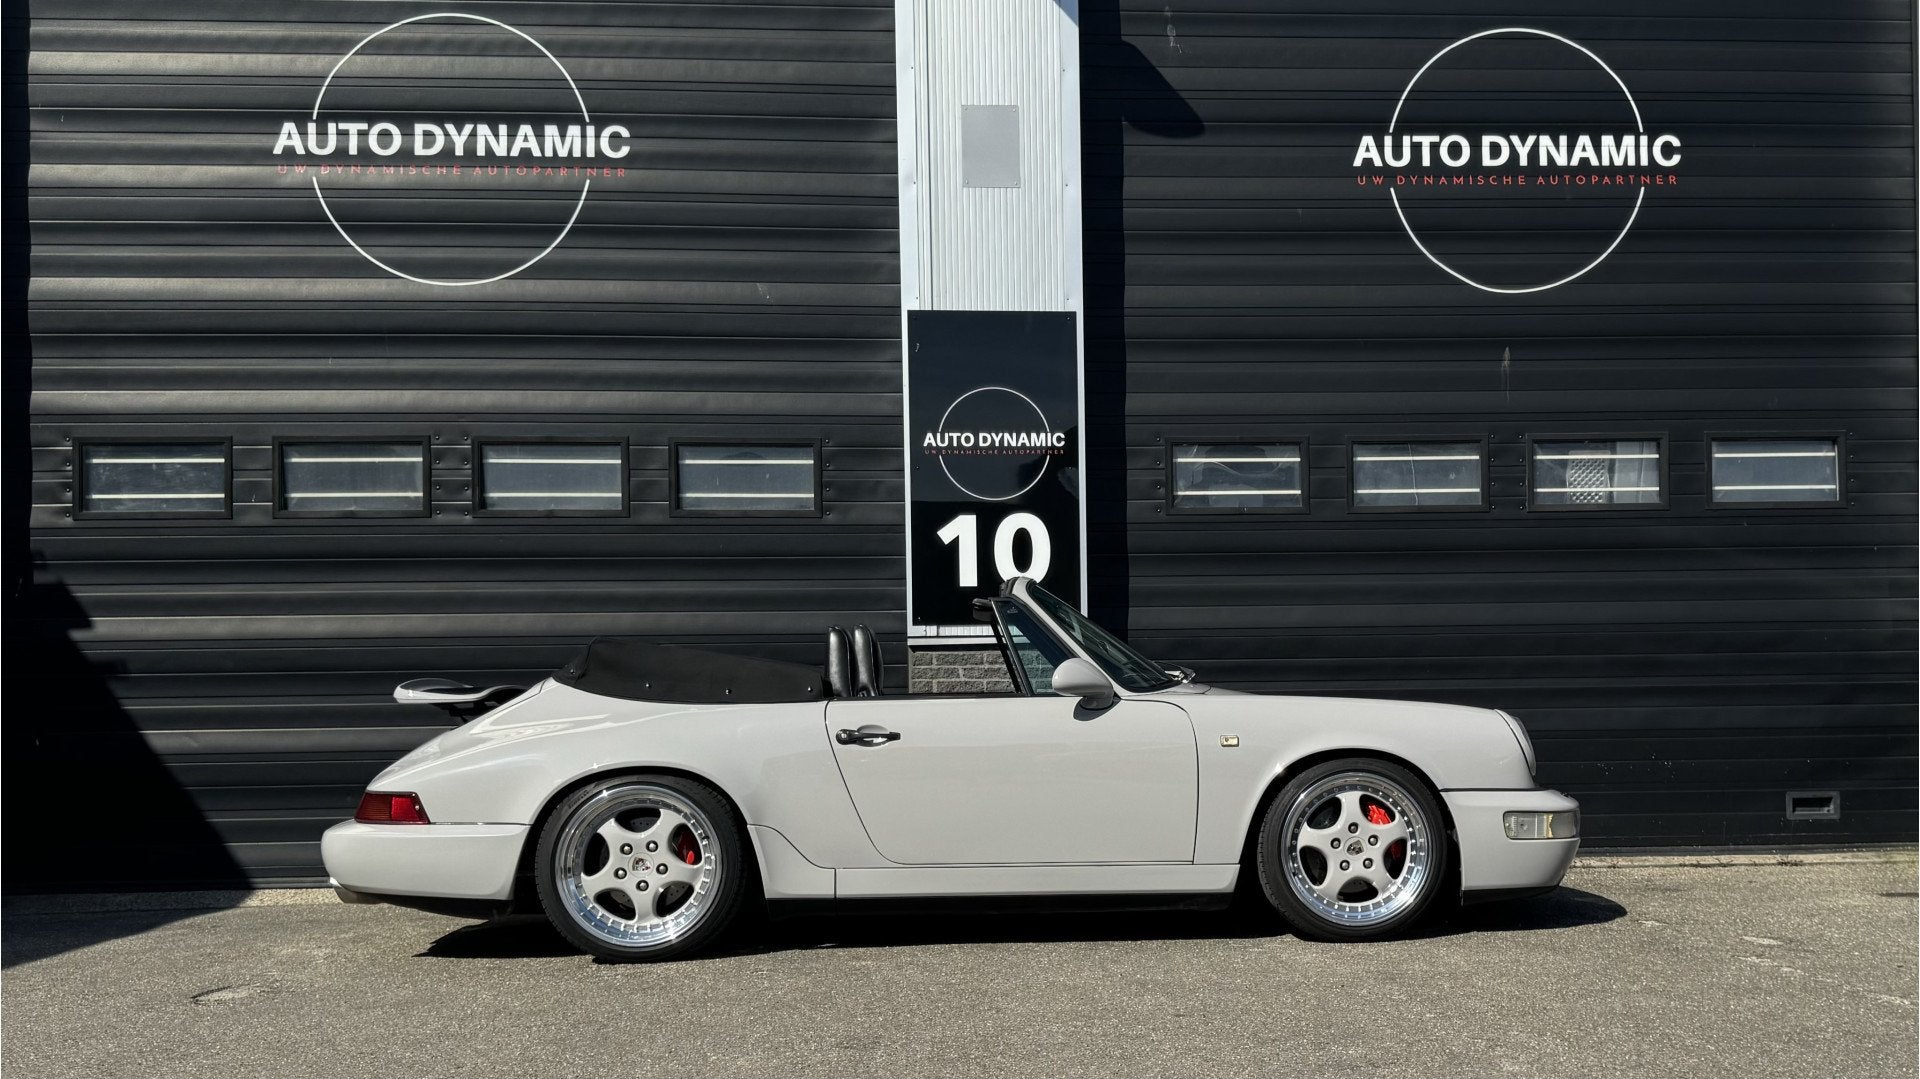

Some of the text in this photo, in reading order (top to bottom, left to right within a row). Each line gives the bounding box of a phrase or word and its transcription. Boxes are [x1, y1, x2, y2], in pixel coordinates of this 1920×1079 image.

[272, 122, 631, 159] AUTO DYNAMIC
[1352, 134, 1682, 167] AUTO DYNAMIC
[277, 163, 626, 178] UW DYNAMISCHE AUTOPARTNER
[1357, 175, 1678, 186] UW DYNAMISCHE AUTOPARTNER
[923, 432, 1066, 447] AUTO DYNAMIC
[936, 512, 1051, 587] 10
